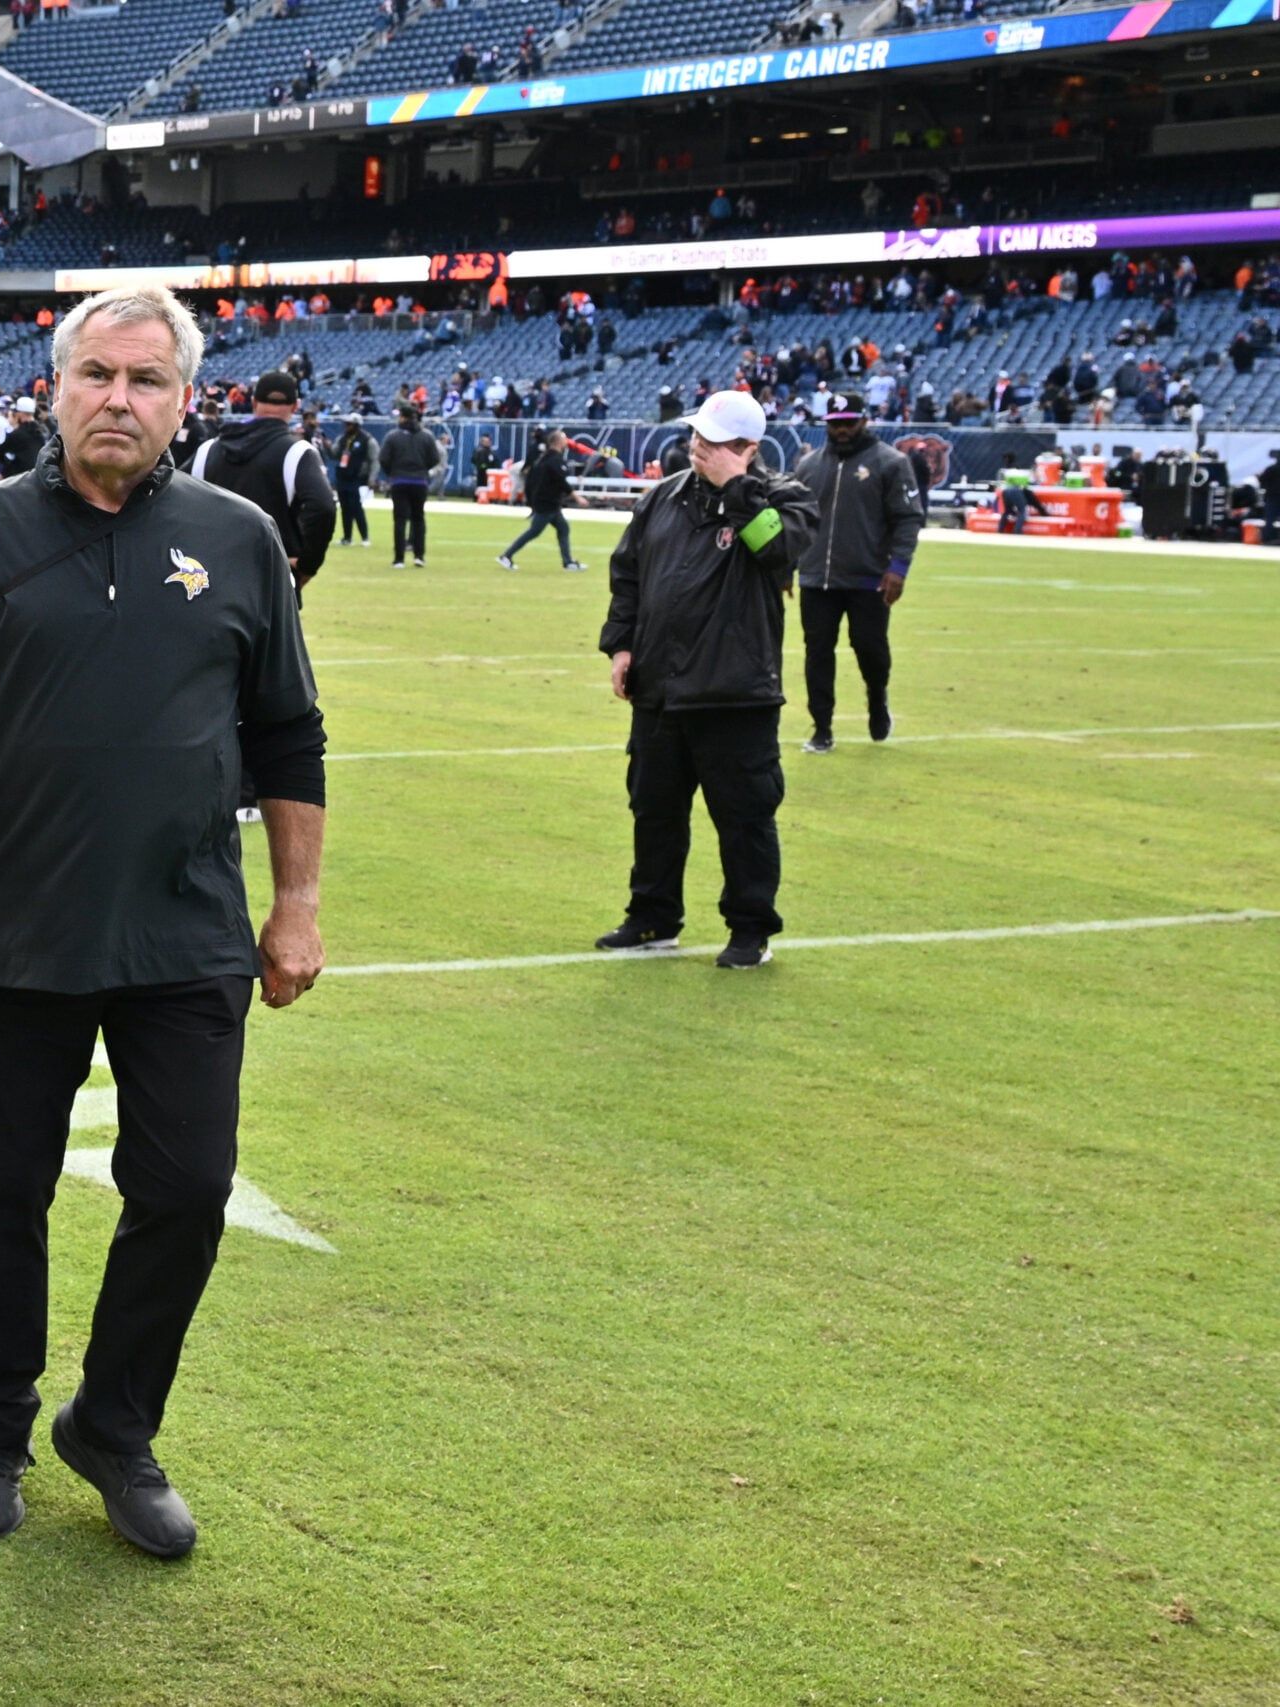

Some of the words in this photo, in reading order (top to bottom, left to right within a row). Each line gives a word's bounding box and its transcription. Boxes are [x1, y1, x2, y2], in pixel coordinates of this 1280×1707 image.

[642, 54, 773, 96] INTERCEPT
[783, 40, 890, 79] CANCER
[999, 227, 1038, 252] CAM
[1039, 223, 1097, 249] AKERS
[730, 244, 768, 262] Stats
